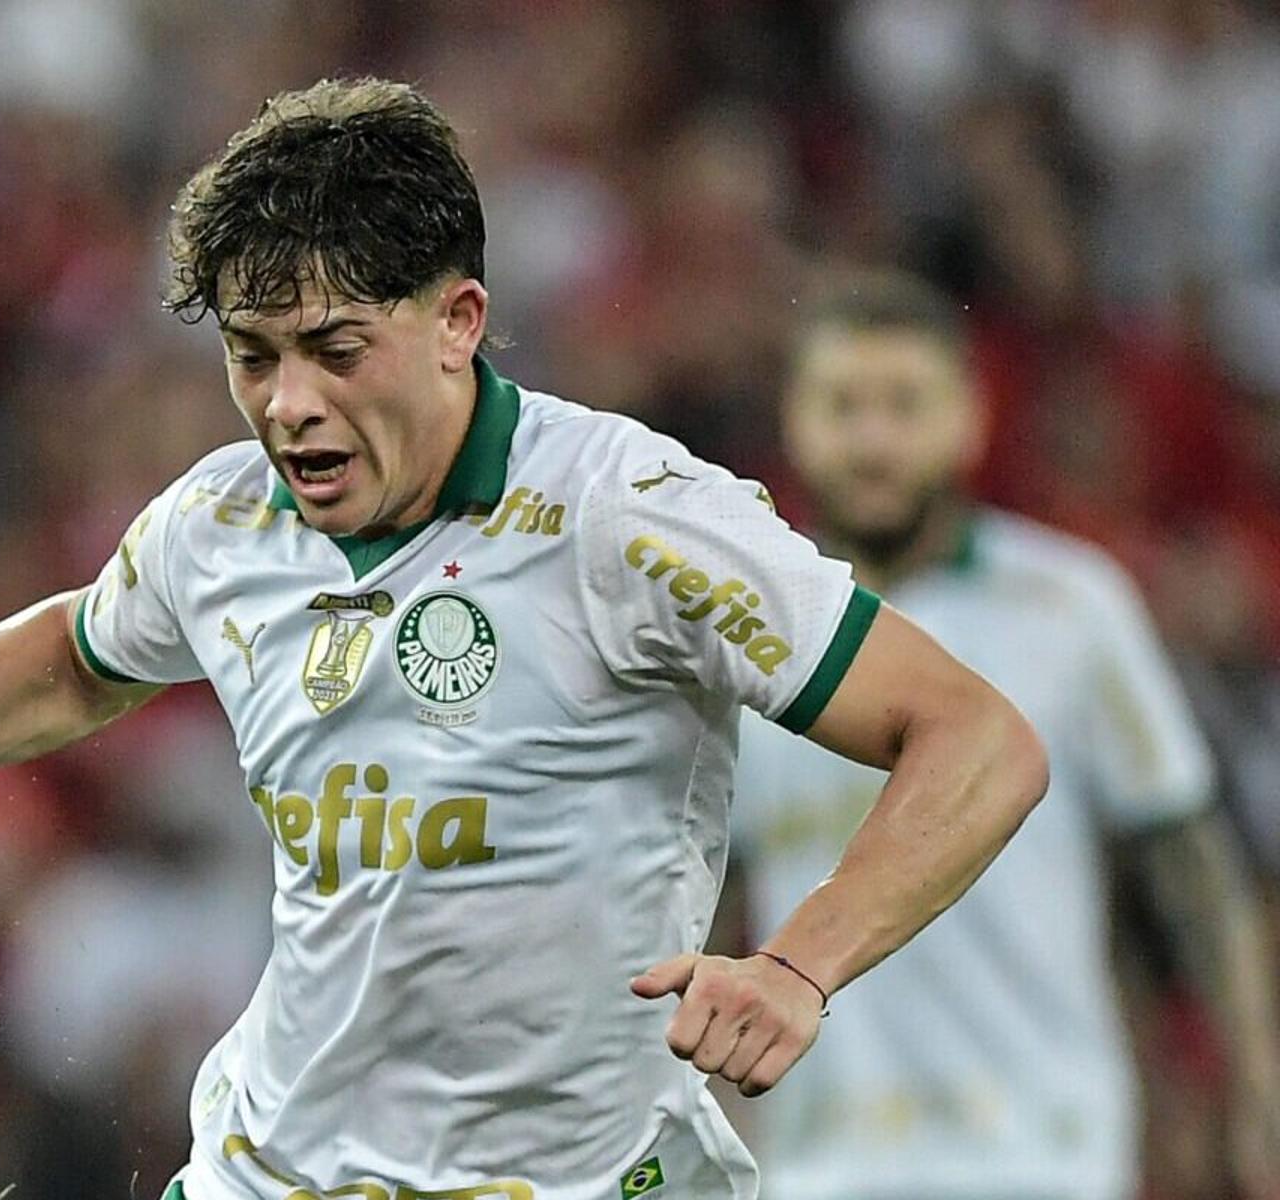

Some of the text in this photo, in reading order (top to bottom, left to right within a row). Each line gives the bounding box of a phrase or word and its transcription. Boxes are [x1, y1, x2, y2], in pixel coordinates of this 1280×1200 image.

[398, 640, 496, 702] PALMEIRAS
[624, 534, 793, 677] crefisa
[249, 763, 496, 896] refisa
